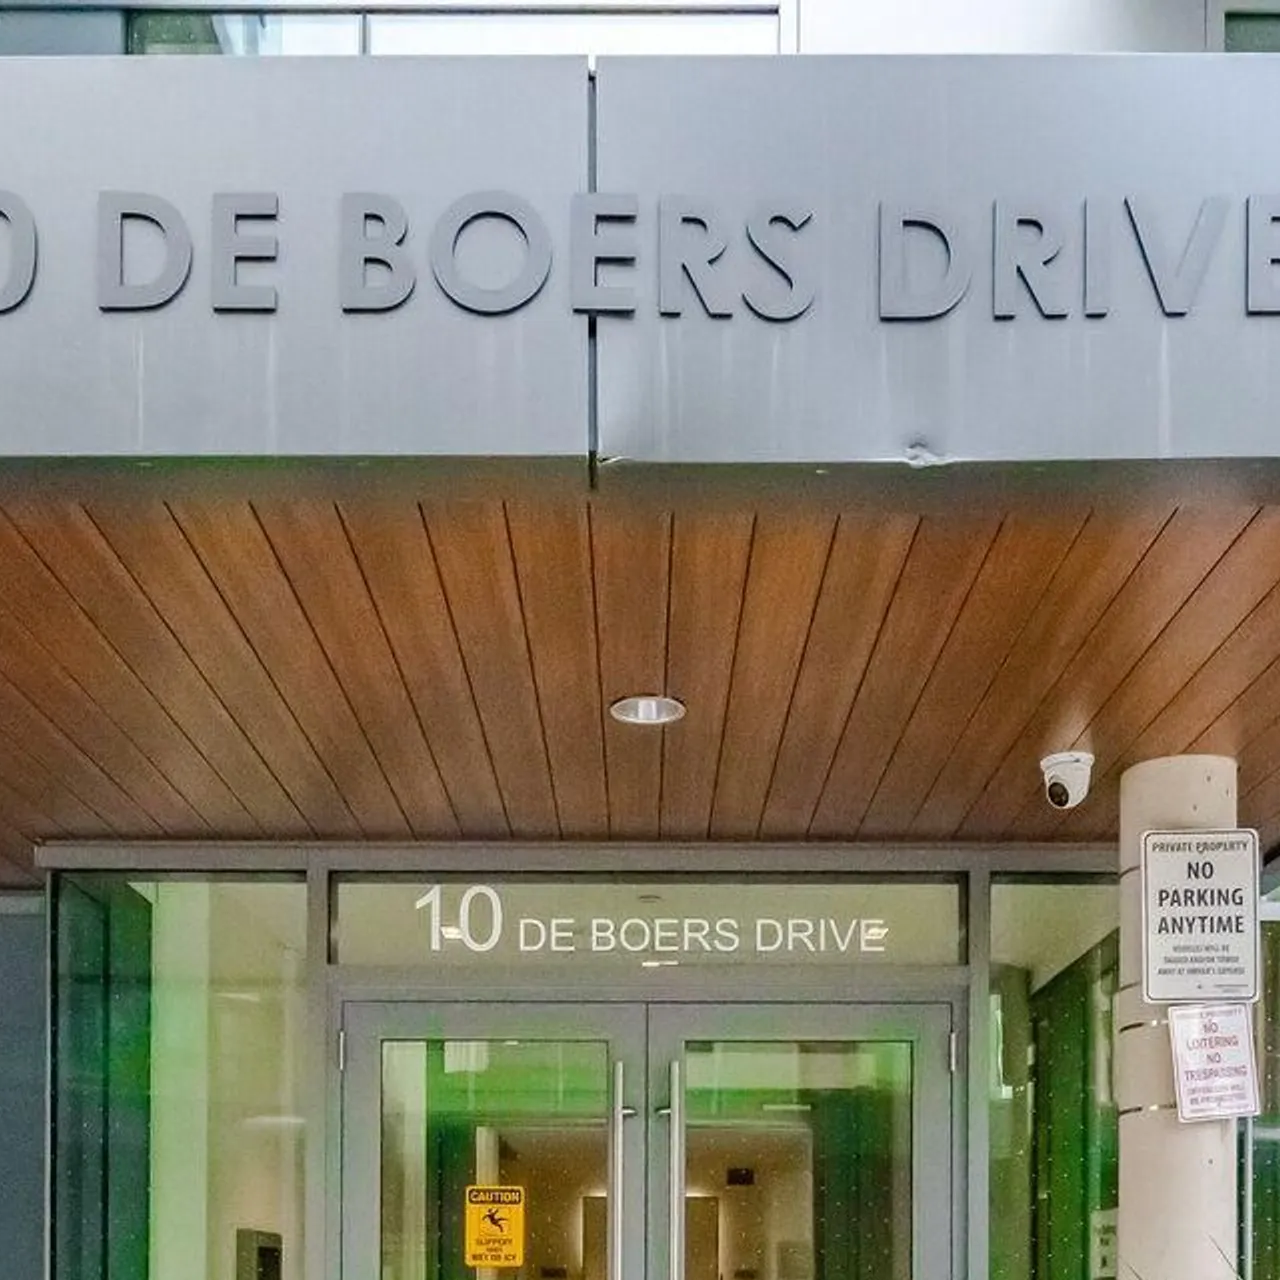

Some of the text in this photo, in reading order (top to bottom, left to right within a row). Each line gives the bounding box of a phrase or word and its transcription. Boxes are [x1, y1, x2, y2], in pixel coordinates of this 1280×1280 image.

[98, 190, 280, 313] DE
[342, 190, 816, 322] BOERS
[1188, 862, 1214, 879] NO
[1158, 888, 1243, 907] PARKING
[416, 884, 887, 952] 10 DE BOERS DRIVE
[1158, 916, 1244, 934] ANYTIME
[1203, 1022, 1218, 1033] NO
[1206, 1052, 1220, 1063] NO
[470, 1192, 519, 1202] CAUTION
